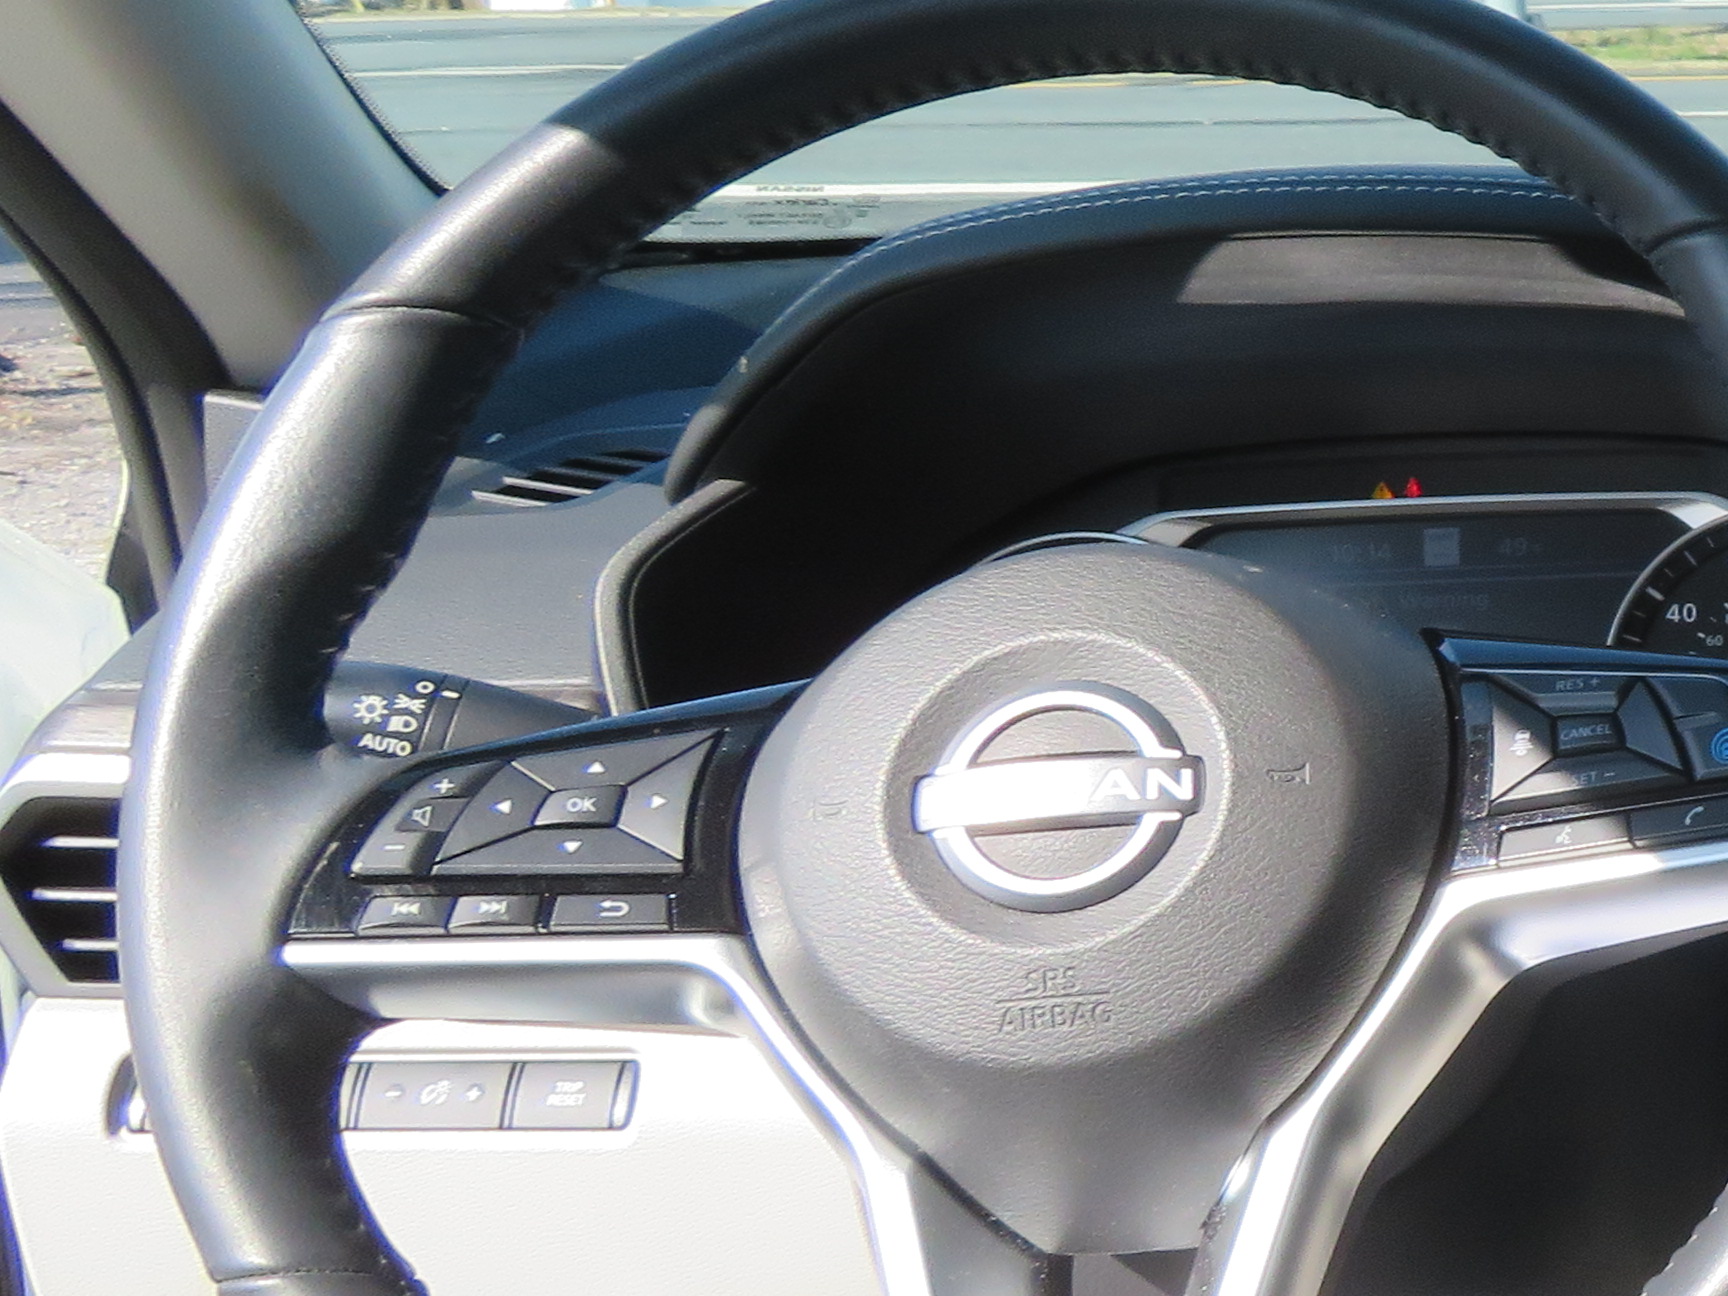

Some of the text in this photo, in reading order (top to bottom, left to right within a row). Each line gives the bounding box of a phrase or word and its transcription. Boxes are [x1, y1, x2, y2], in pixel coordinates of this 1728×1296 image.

[1665, 602, 1698, 623] 40
[1705, 634, 1724, 647] 60
[1555, 677, 1584, 693] RES
[1559, 722, 1612, 742] CANCEL
[358, 732, 413, 757] AUTO
[566, 797, 597, 813] OK
[1024, 966, 1077, 995] SRS
[998, 1000, 1113, 1033] AIRBAG
[547, 1093, 586, 1106] RESET
